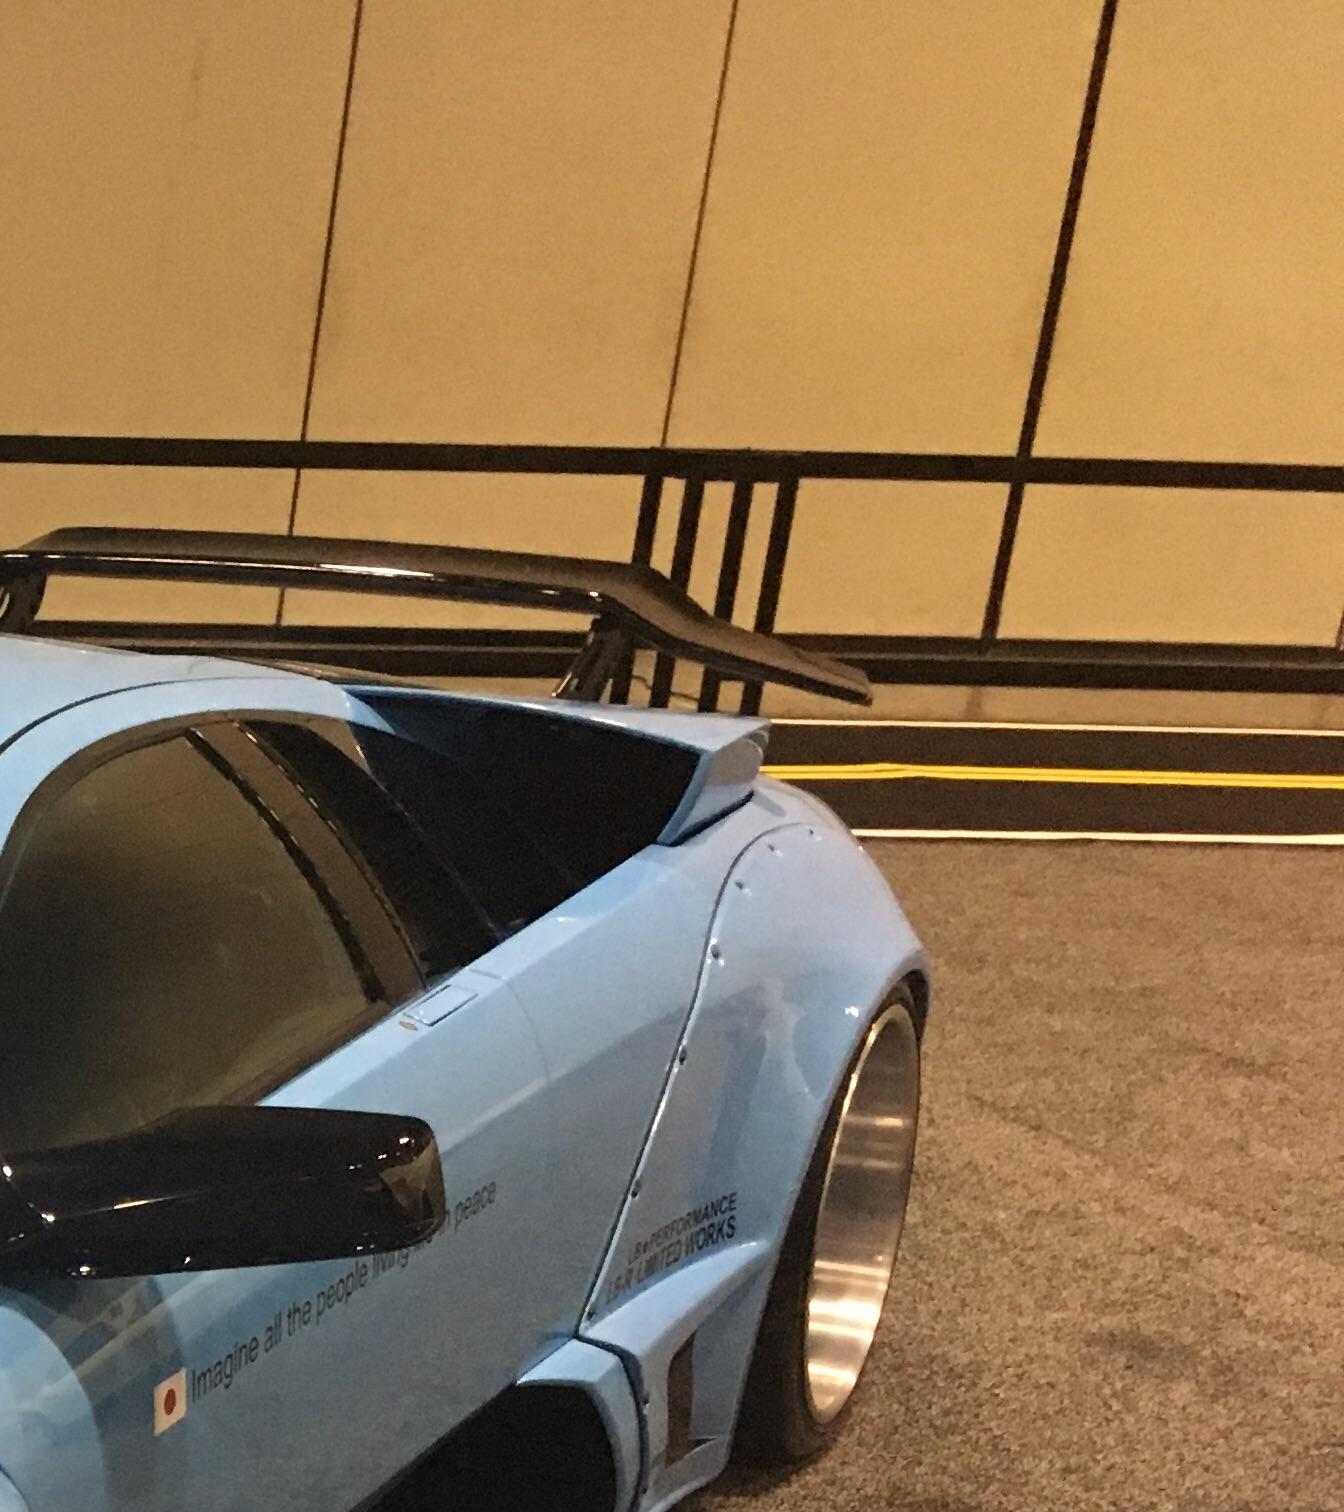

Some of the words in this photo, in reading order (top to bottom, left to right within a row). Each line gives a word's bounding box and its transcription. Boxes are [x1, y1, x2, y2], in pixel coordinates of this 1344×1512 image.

[191, 1336, 260, 1402] Imagine
[264, 1311, 282, 1353] all
[286, 1300, 313, 1337] the
[315, 1260, 368, 1326] people
[454, 1181, 497, 1233] peace
[684, 1214, 736, 1257] WORKS
